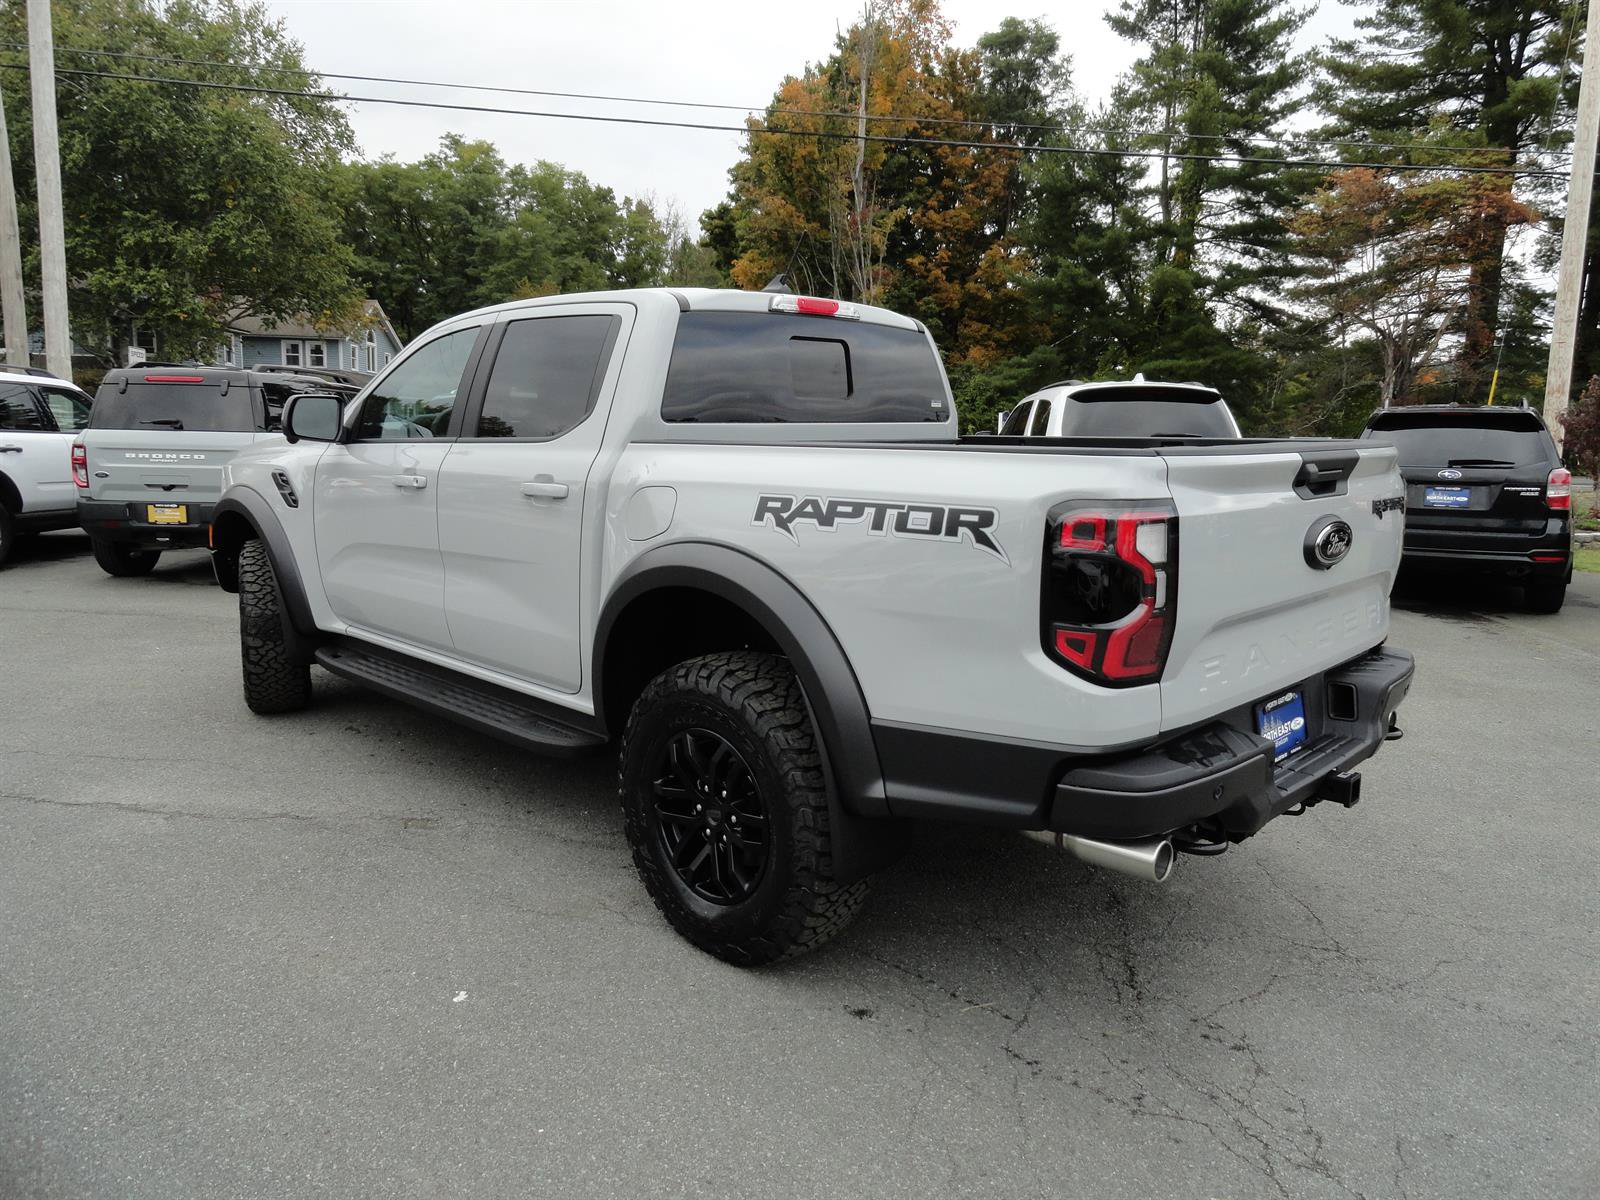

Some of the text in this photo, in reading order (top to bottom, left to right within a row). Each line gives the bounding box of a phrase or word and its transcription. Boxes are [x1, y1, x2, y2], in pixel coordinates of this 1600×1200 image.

[752, 493, 1009, 563] RAPTOR
[1326, 532, 1348, 556] Ford
[1199, 604, 1382, 692] RANGER
[1278, 720, 1292, 736] EAST
